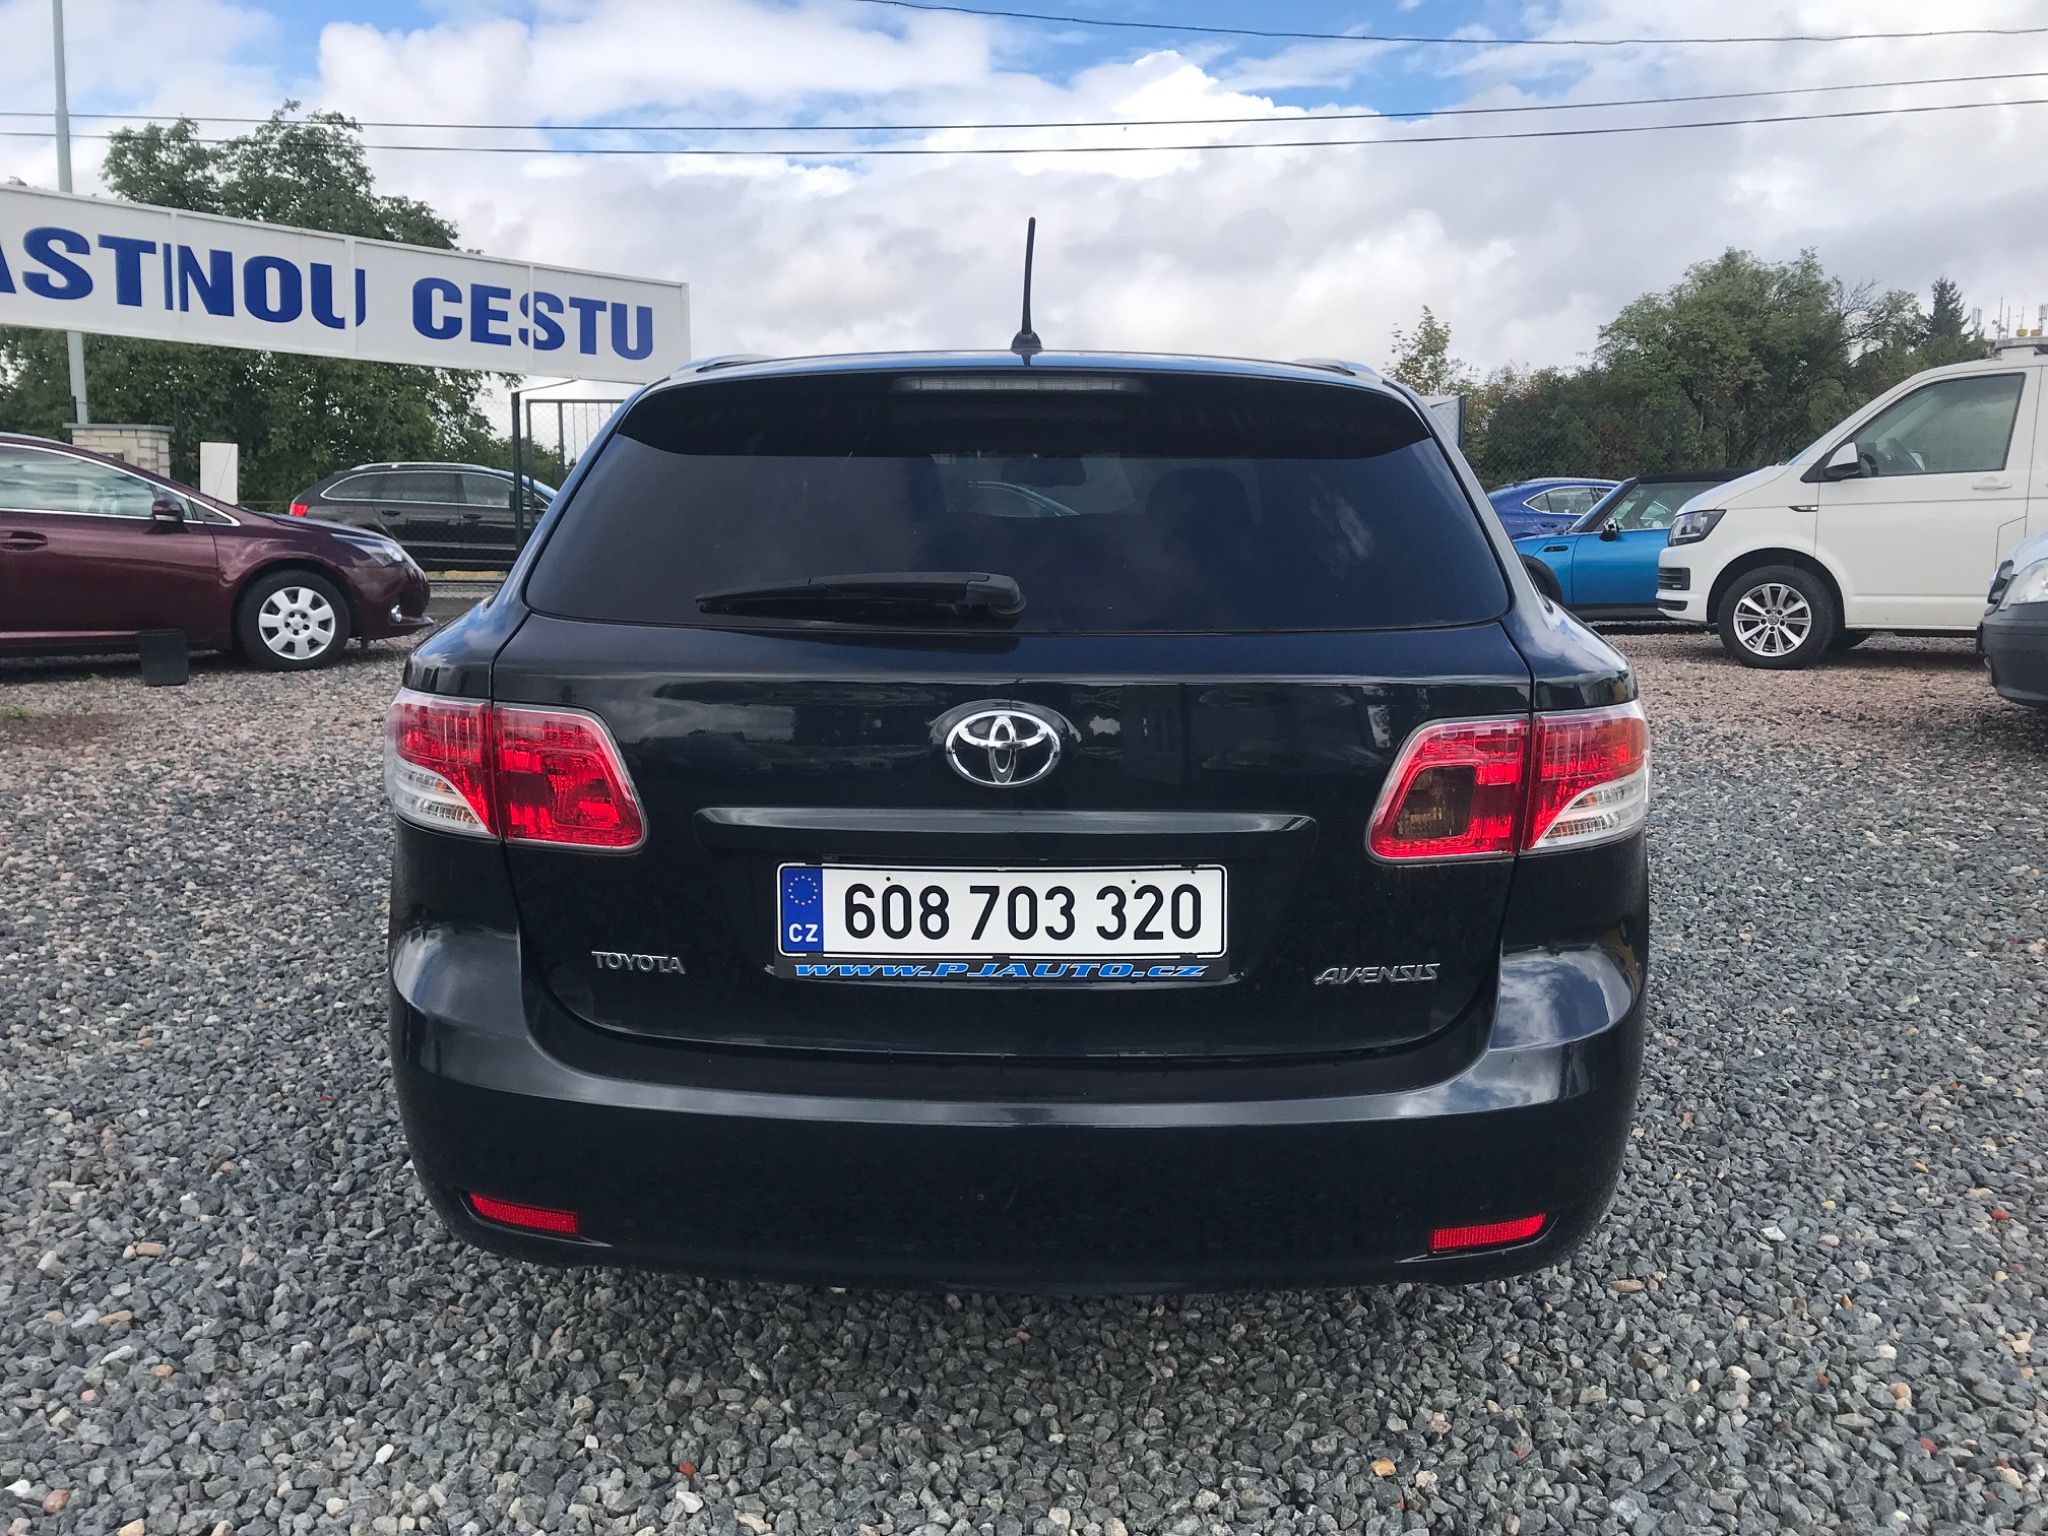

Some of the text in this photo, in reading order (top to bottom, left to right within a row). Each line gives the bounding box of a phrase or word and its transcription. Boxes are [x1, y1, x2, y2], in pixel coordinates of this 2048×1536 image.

[0, 226, 654, 361] STNOU CESTU
[844, 883, 1202, 941] 608 703 320
[788, 923, 819, 943] CZ
[591, 951, 686, 974] TOYOTA
[1314, 963, 1441, 985] AVENSIS
